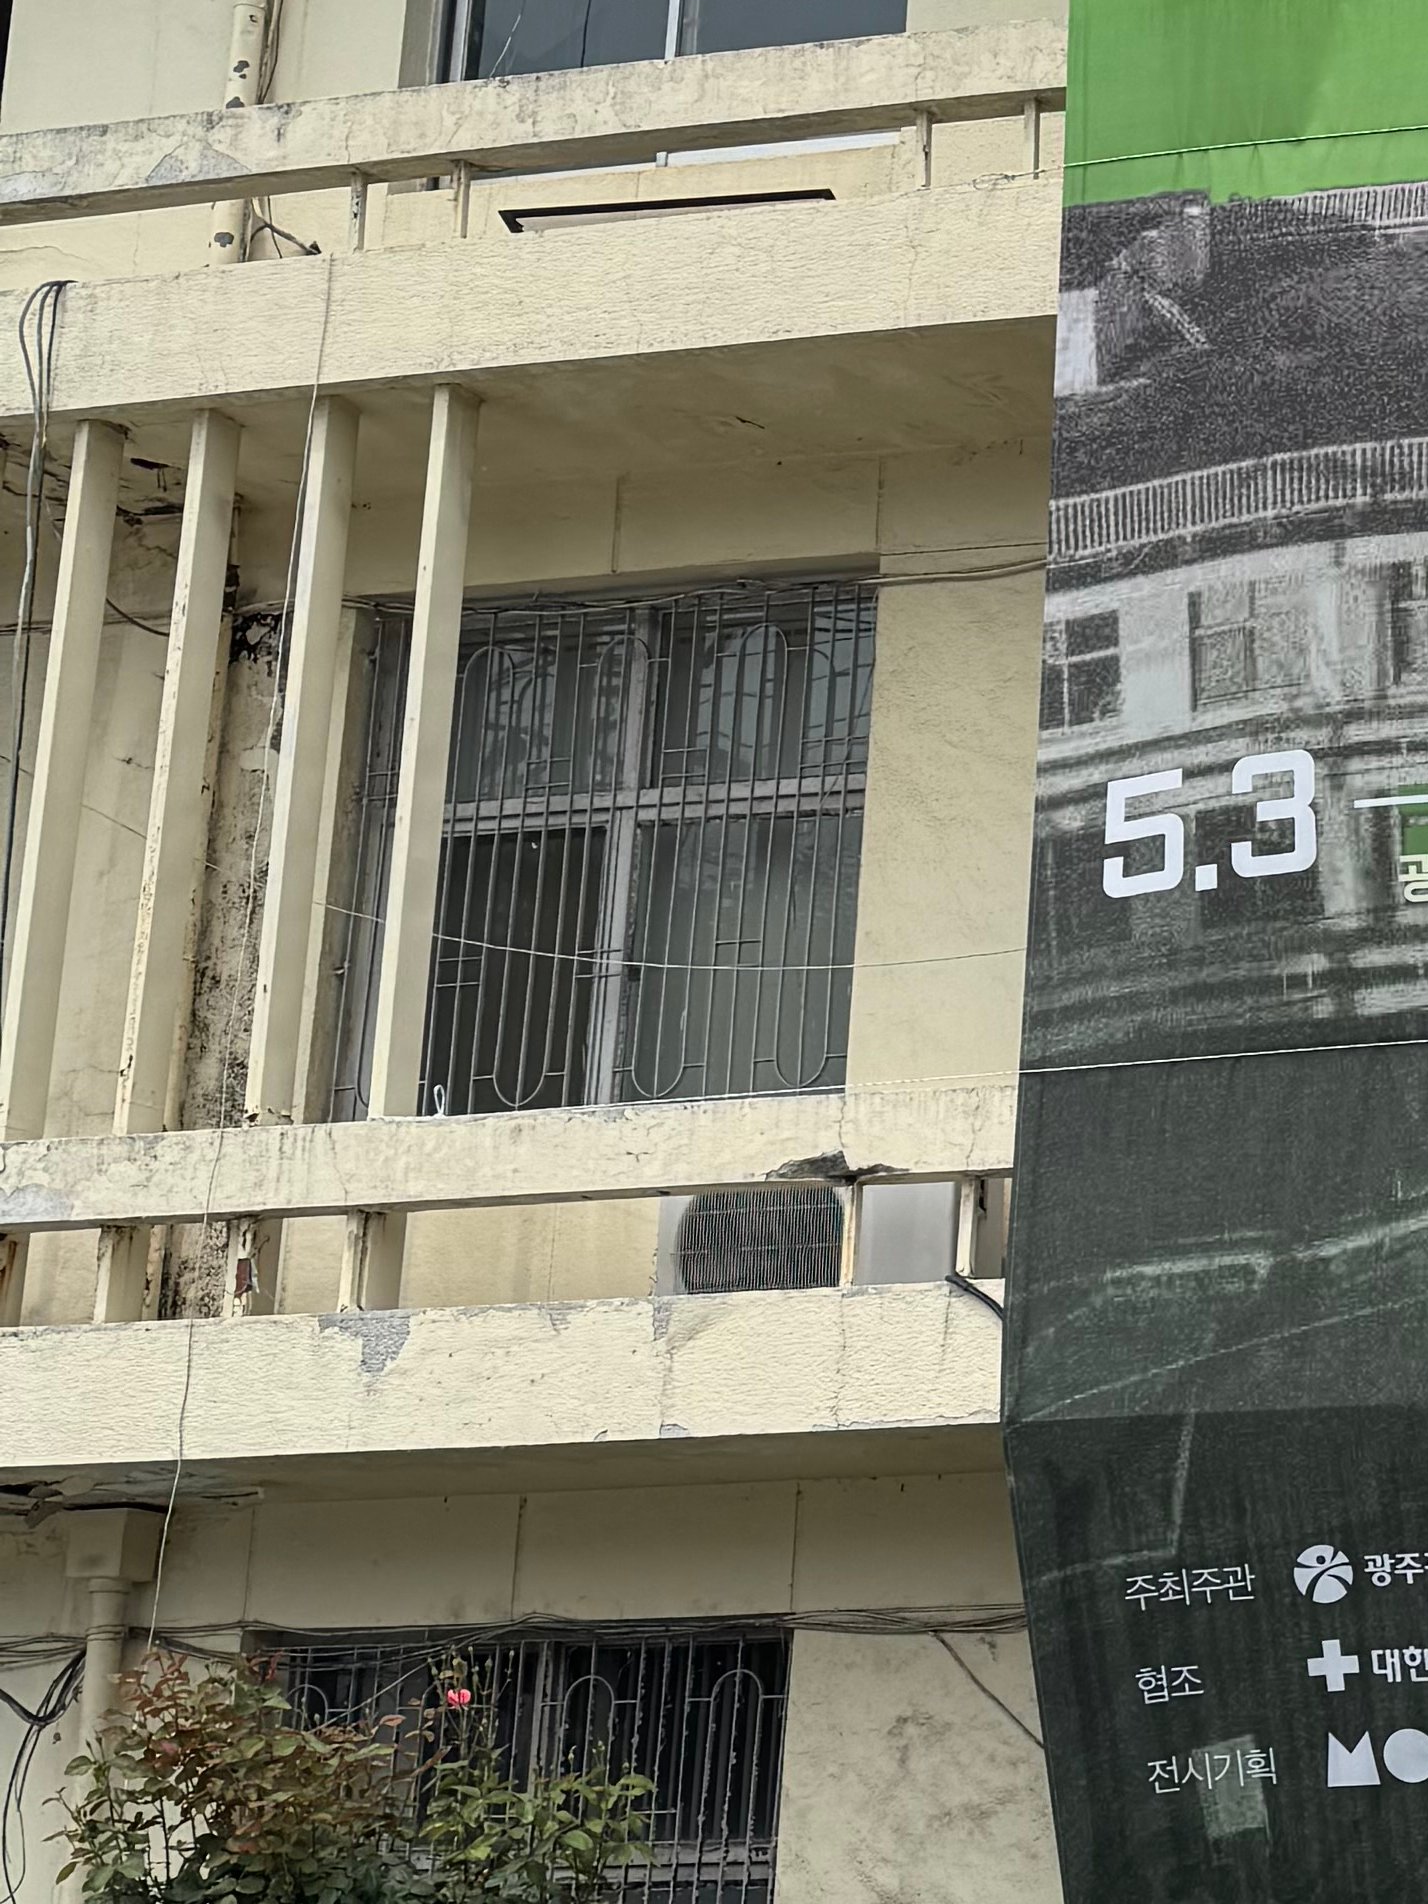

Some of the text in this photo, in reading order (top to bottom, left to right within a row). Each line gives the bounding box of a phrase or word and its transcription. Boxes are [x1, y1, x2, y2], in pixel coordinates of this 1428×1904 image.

[1101, 748, 1319, 899] 5.3
[1124, 1562, 1256, 1611] 주최주관
[1135, 1664, 1205, 1705] 협조
[1147, 1746, 1278, 1795] 전시기획
